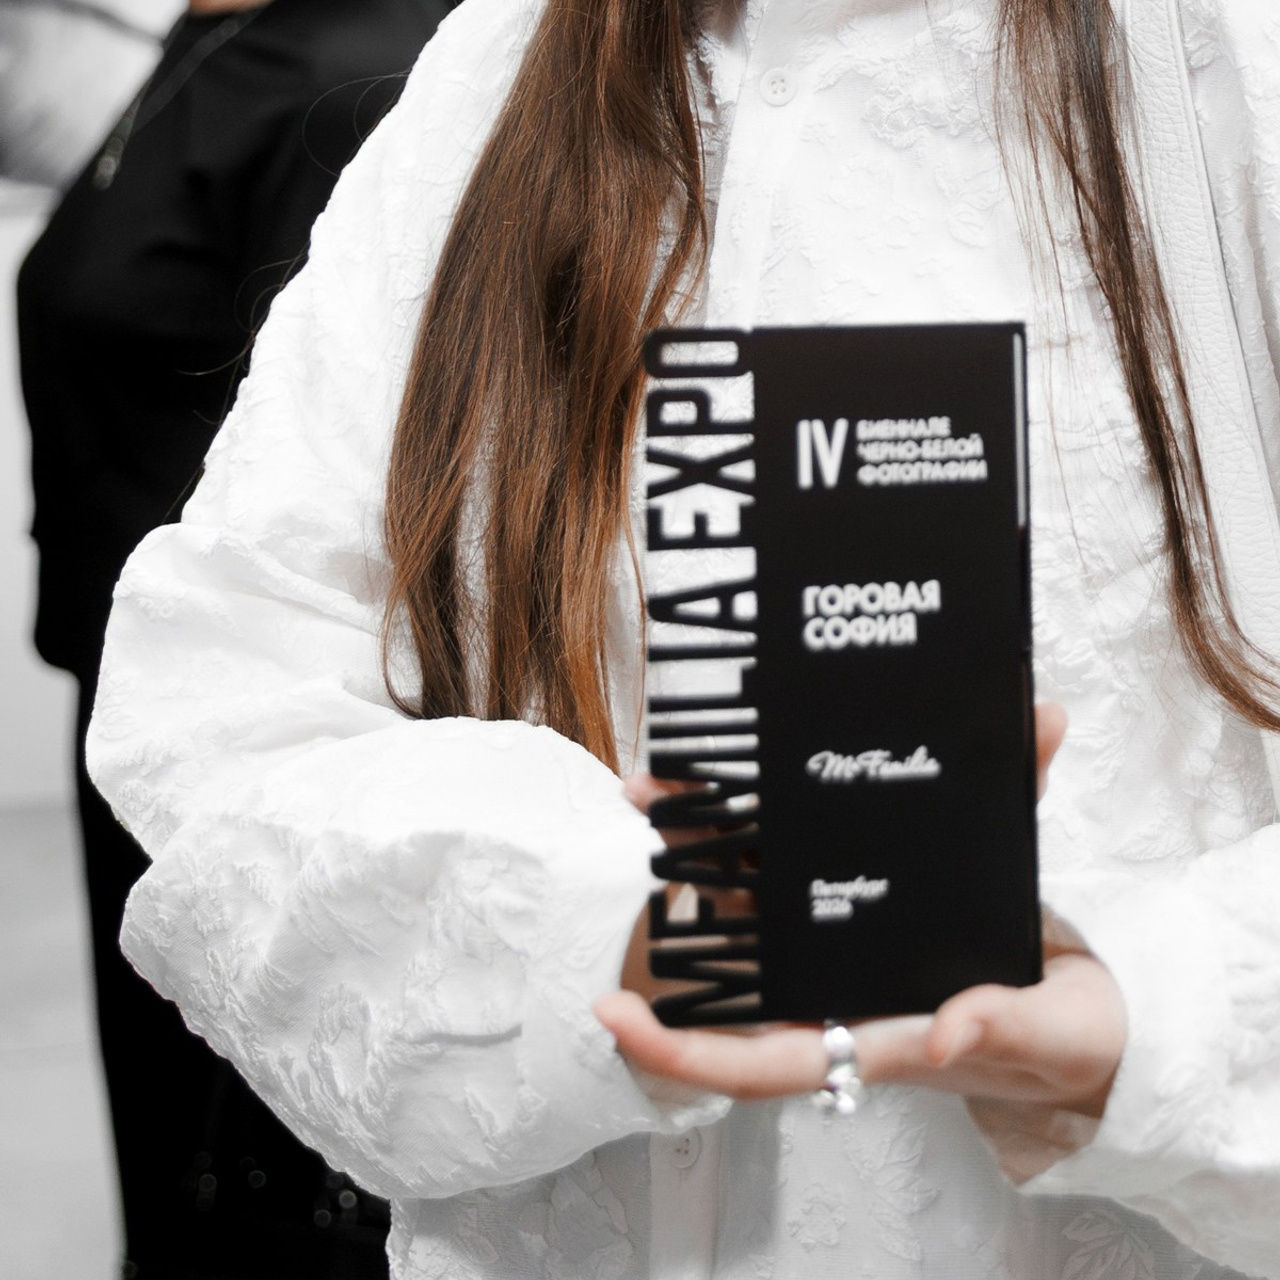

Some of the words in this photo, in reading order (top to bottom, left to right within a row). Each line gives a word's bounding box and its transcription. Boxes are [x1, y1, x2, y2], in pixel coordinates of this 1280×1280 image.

[645, 328, 755, 552] EXPO
[798, 418, 849, 489] IV
[803, 579, 941, 618] ГОРОВАЯ
[804, 612, 917, 651] СОФИЯ
